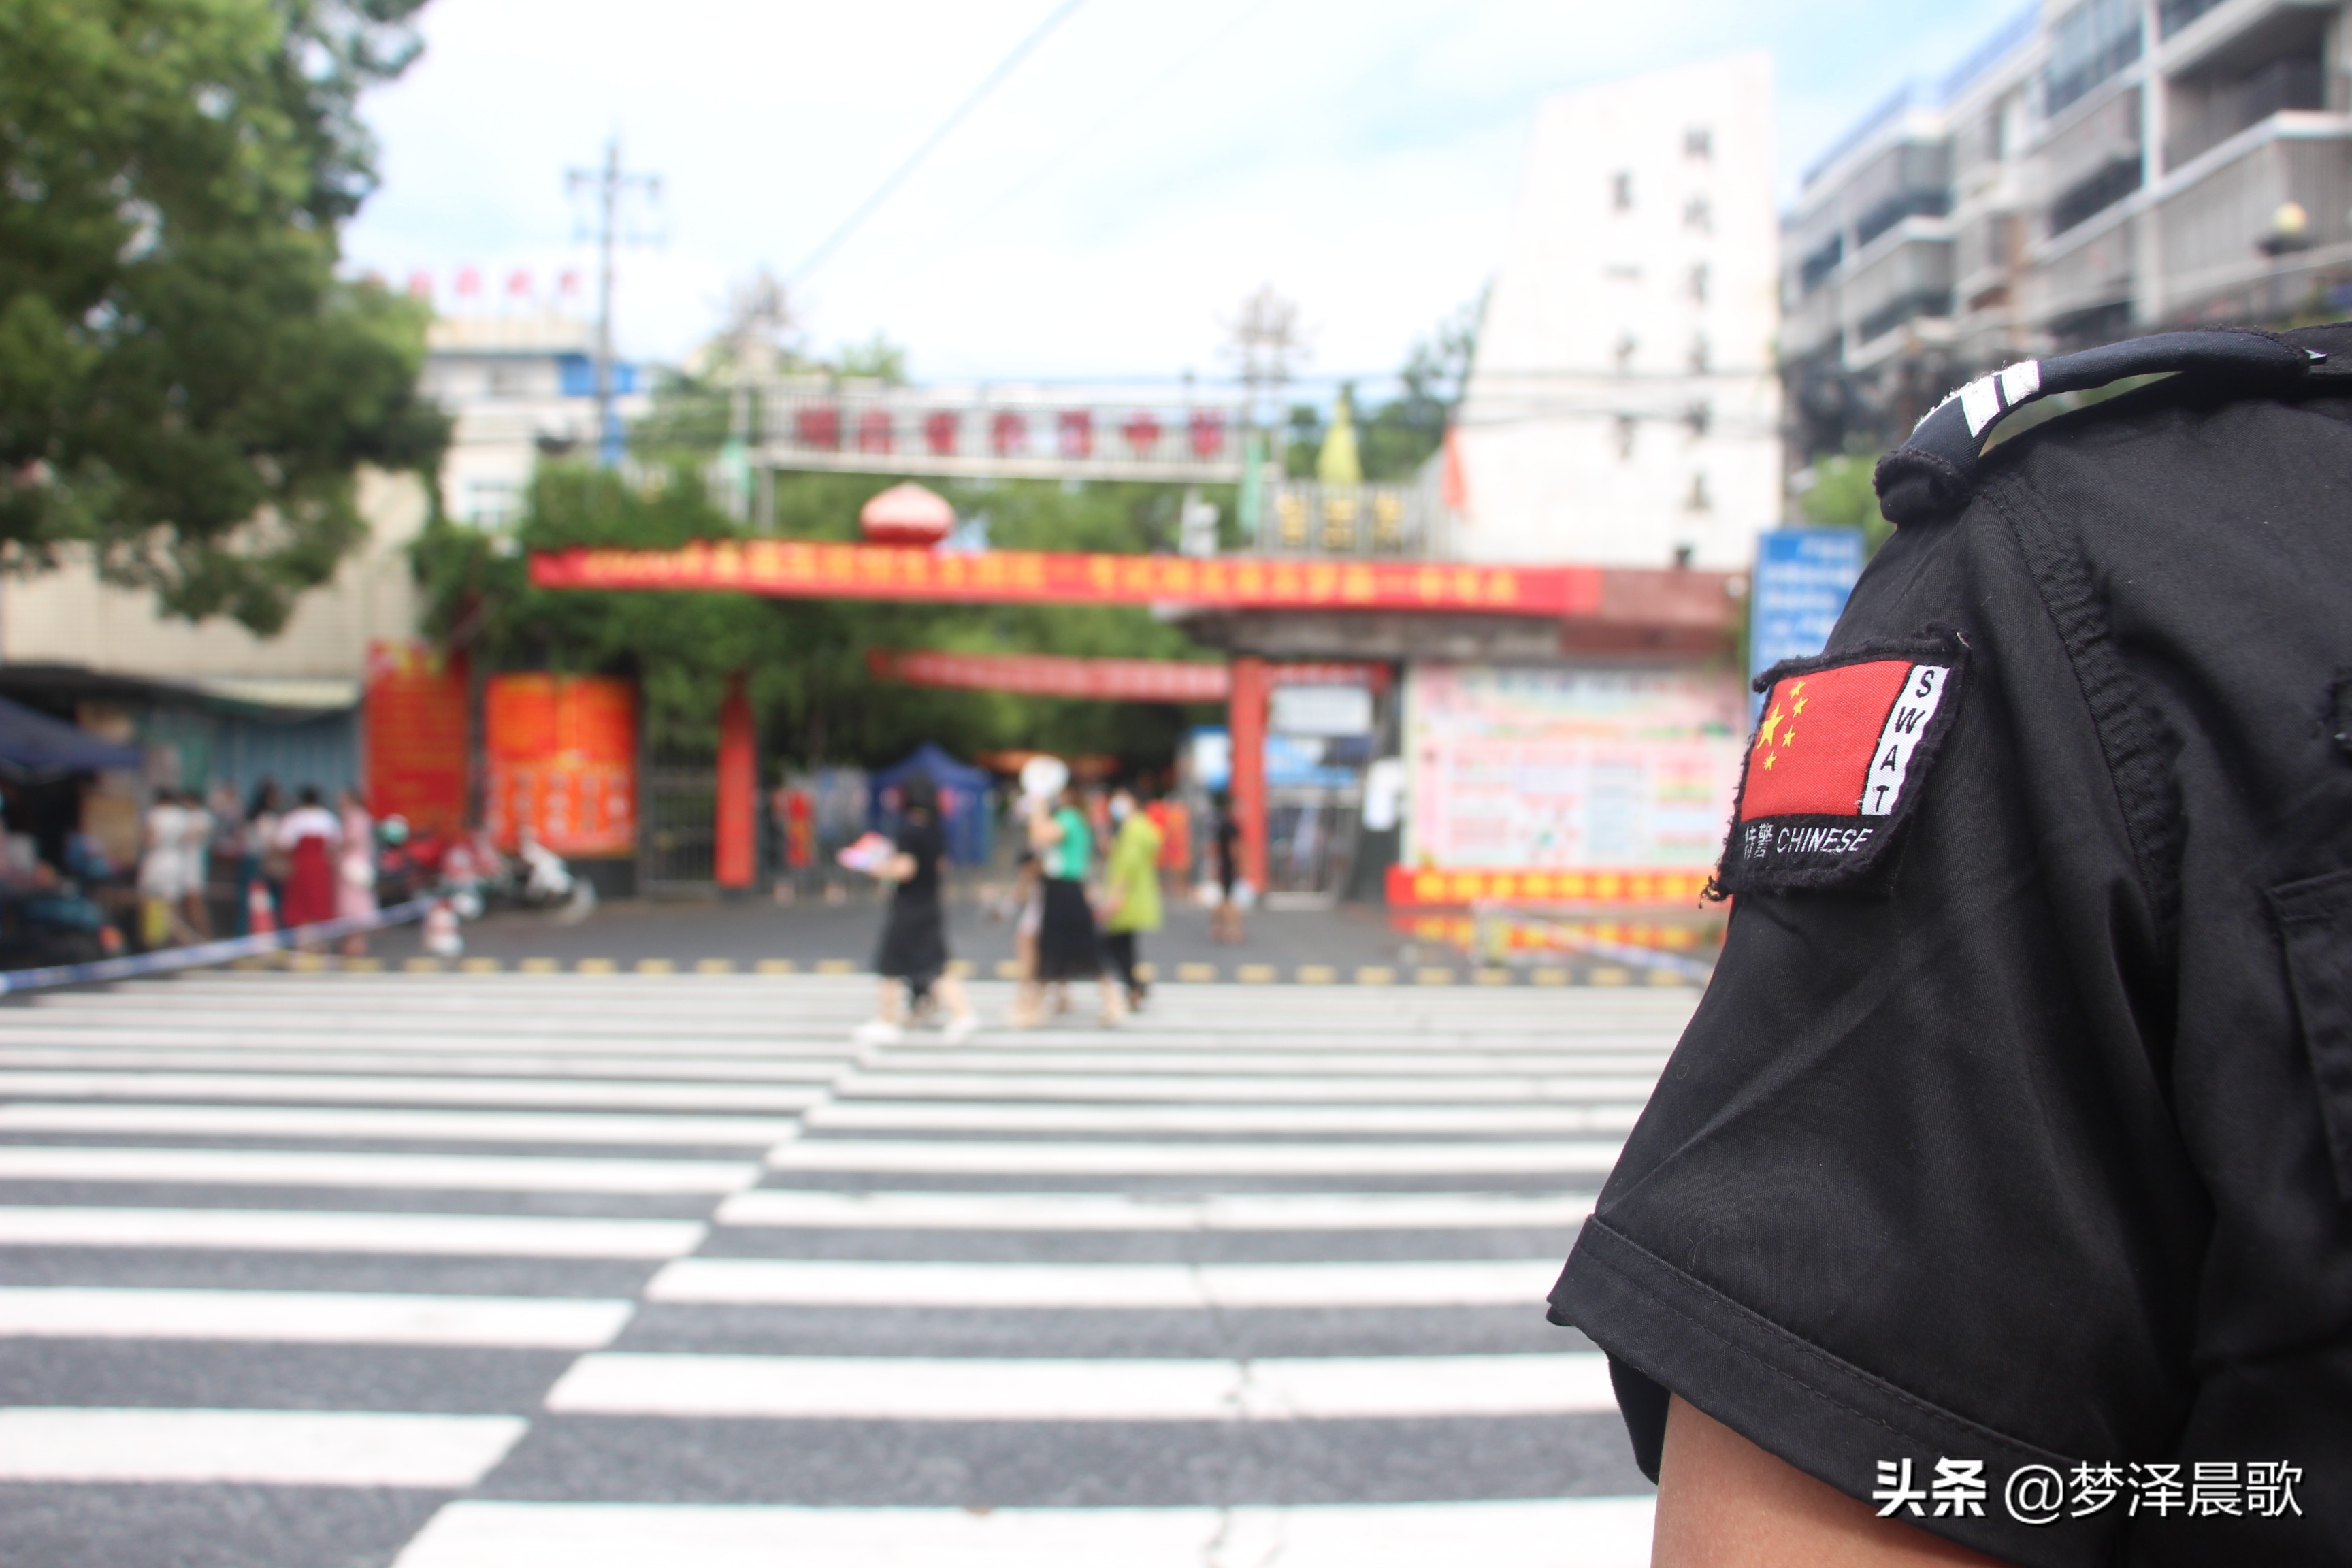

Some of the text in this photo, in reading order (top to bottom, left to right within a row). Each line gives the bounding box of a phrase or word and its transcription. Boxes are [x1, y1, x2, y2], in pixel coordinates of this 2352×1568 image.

[1875, 670, 1935, 812] SWAT
[1744, 823, 1874, 860] 特警 CHINESE
